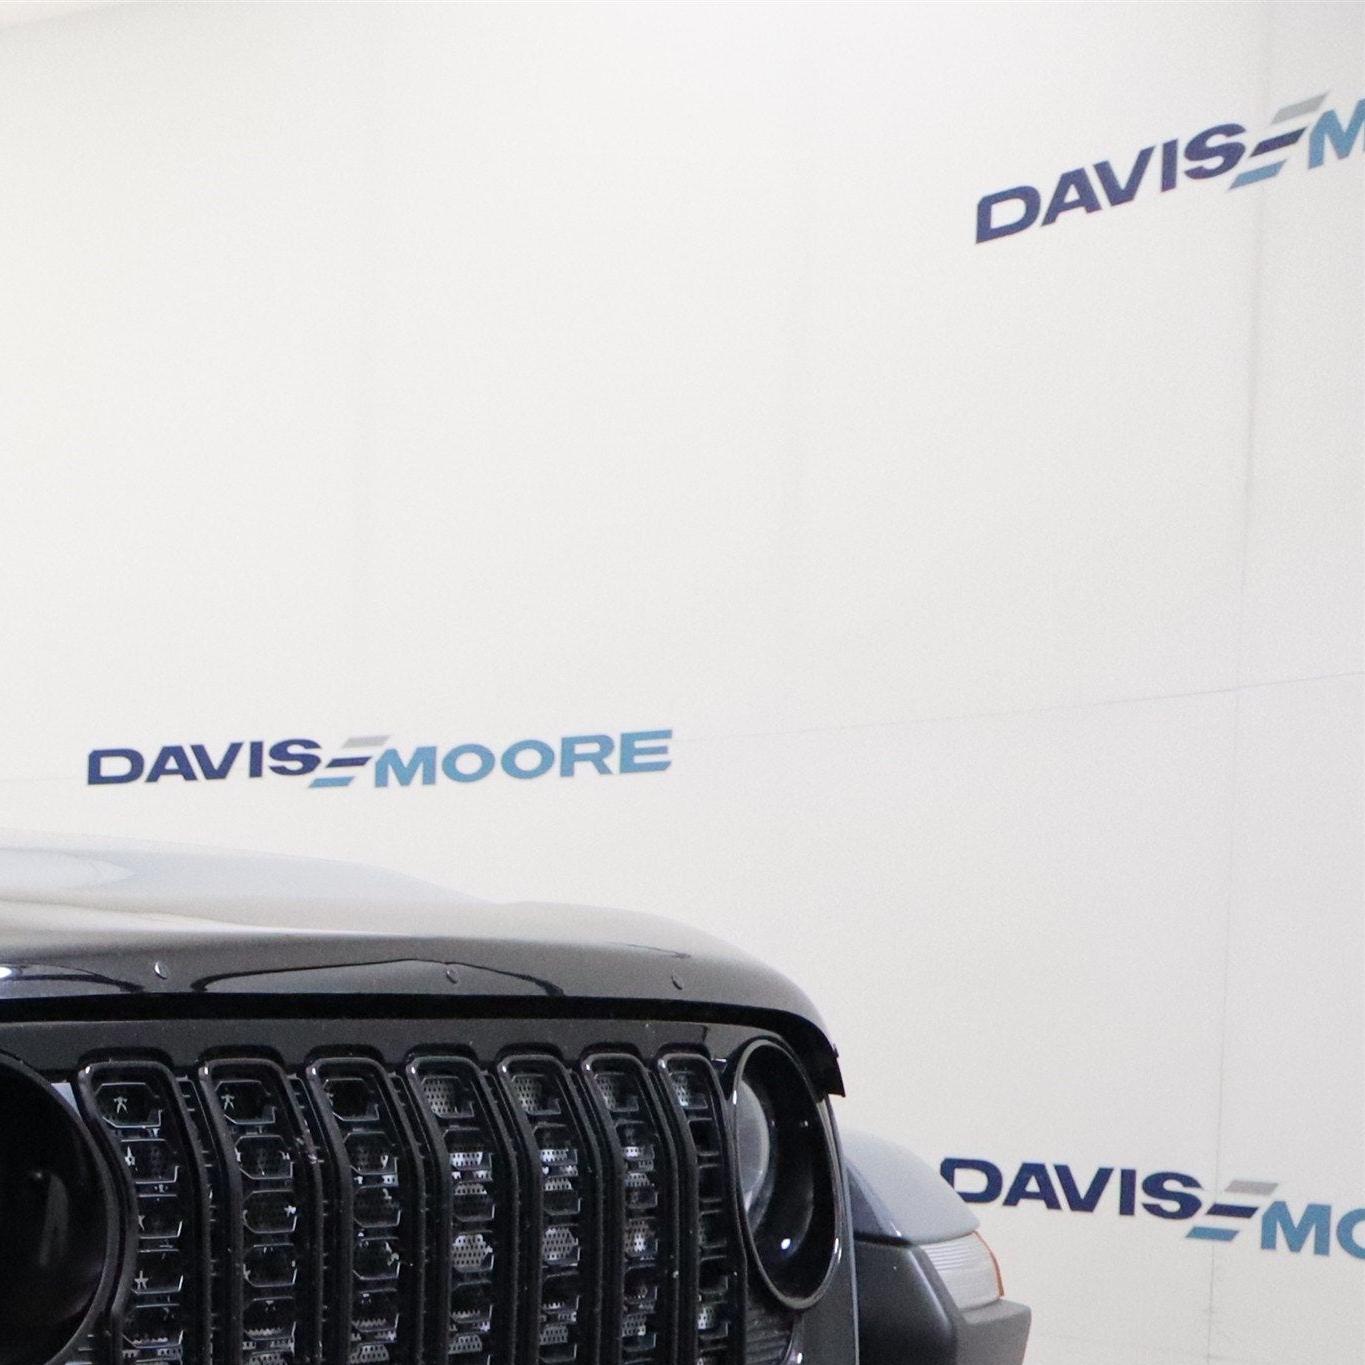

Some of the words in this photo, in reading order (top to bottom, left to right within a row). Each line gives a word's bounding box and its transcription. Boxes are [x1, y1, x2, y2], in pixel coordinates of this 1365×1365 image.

[975, 123, 1246, 244] DAVIS
[87, 737, 322, 786] DAVIS
[375, 729, 674, 788] MOORE
[939, 1157, 1204, 1220] DAVIS
